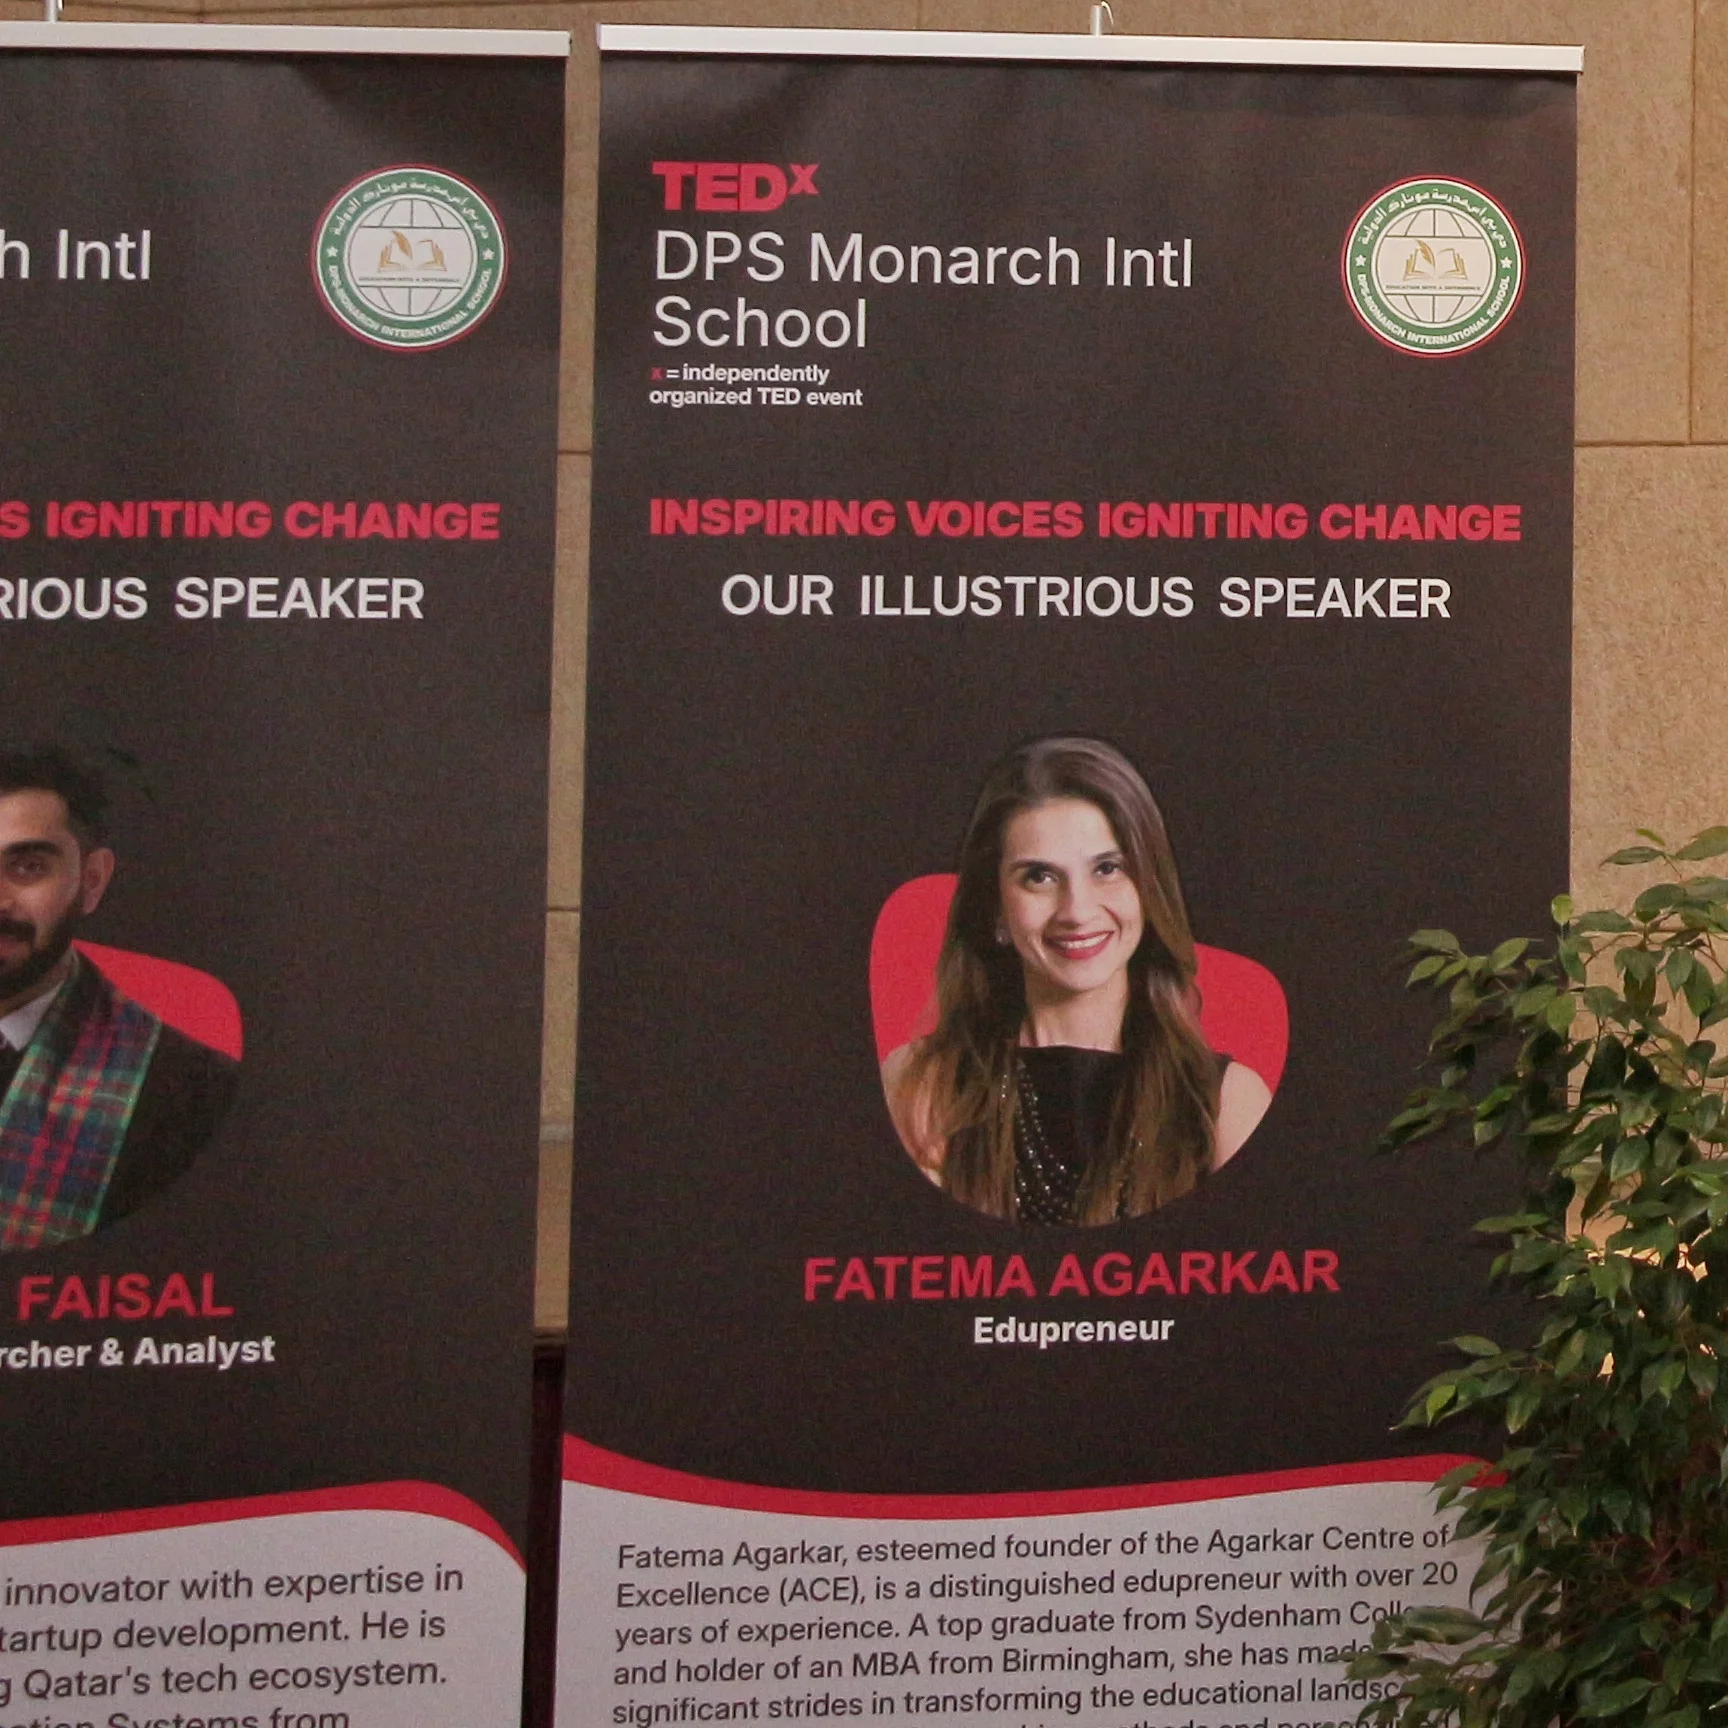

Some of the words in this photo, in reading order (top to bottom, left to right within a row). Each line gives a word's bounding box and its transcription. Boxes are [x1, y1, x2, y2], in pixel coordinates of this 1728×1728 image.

[58, 229, 150, 280] Intl
[656, 230, 785, 282] DPS
[810, 232, 1080, 286] Monarch
[1106, 237, 1192, 287] Intl
[653, 295, 866, 348] School
[1407, 317, 1490, 345] INTERNATIONAL
[1486, 275, 1510, 319] SCHOOL
[682, 363, 830, 385] independently
[649, 387, 752, 408] organized
[757, 387, 800, 404] TED
[806, 389, 863, 405] event
[46, 501, 272, 540] IGNITING
[285, 501, 501, 540] CHANGE
[650, 498, 895, 537] INSPIRING
[907, 499, 1084, 539] VOICES
[1098, 501, 1309, 541] IGNITING
[1319, 503, 1522, 543] CHANGE
[175, 577, 425, 620] SPEAKER
[721, 574, 833, 617] OUR
[860, 574, 1195, 619] ILLUSTRIOUS
[1219, 576, 1452, 620] SPEAKER
[17, 1272, 235, 1320] FAISAL
[803, 1254, 1037, 1301] FATEMA
[1048, 1249, 1341, 1297] AGARKAR
[99, 1337, 124, 1366] &
[133, 1335, 276, 1371] Analyst
[973, 1315, 1175, 1349] Edupreneur
[618, 1545, 724, 1569] Fatema
[733, 1540, 848, 1571] Agarkar,
[856, 1535, 996, 1562] esteemed
[1004, 1532, 1112, 1559] founder
[1120, 1531, 1148, 1556] of
[1155, 1530, 1199, 1554] the
[1206, 1528, 1315, 1559] Agarkar
[1323, 1526, 1414, 1550] Centre
[1422, 1524, 1451, 1548] of
[5, 1576, 170, 1606] innovator
[180, 1569, 254, 1600] with
[265, 1565, 425, 1602] expertise
[434, 1563, 464, 1593] in
[616, 1581, 770, 1608] Excellence
[780, 1575, 866, 1607] (ACE),
[874, 1575, 897, 1600] is
[905, 1579, 921, 1599] a
[929, 1570, 1115, 1603] distinguished
[1123, 1569, 1282, 1597] edupreneur
[1289, 1564, 1347, 1589] with
[1355, 1567, 1412, 1587] over
[1421, 1562, 1458, 1586] 20
[113, 1614, 350, 1654] development.
[361, 1610, 410, 1640] He
[419, 1609, 446, 1639] is
[615, 1625, 692, 1652] years
[701, 1619, 730, 1643] of
[737, 1617, 900, 1647] experience.
[907, 1613, 929, 1637] A
[937, 1614, 983, 1641] top
[991, 1609, 1115, 1640] graduate
[1123, 1606, 1187, 1631] from
[1195, 1602, 1341, 1634] Sydenham
[23, 1666, 151, 1700] Qatar's
[161, 1663, 238, 1694] tech
[249, 1659, 447, 1695] ecosystem.
[614, 1660, 667, 1685] and
[676, 1657, 765, 1682] holder
[773, 1655, 802, 1680] of
[809, 1658, 843, 1679] an
[853, 1651, 921, 1677] MBA
[929, 1649, 993, 1675] from
[1002, 1645, 1175, 1676] Birmingham,
[1184, 1640, 1232, 1667] she
[1240, 1640, 1289, 1665] has
[613, 1696, 759, 1728] significant
[768, 1692, 863, 1719] strides
[871, 1692, 895, 1715] in
[903, 1684, 1082, 1715] transforming
[1090, 1684, 1135, 1709] the
[1142, 1679, 1302, 1706] educational
[1310, 1677, 1400, 1703] landsc
